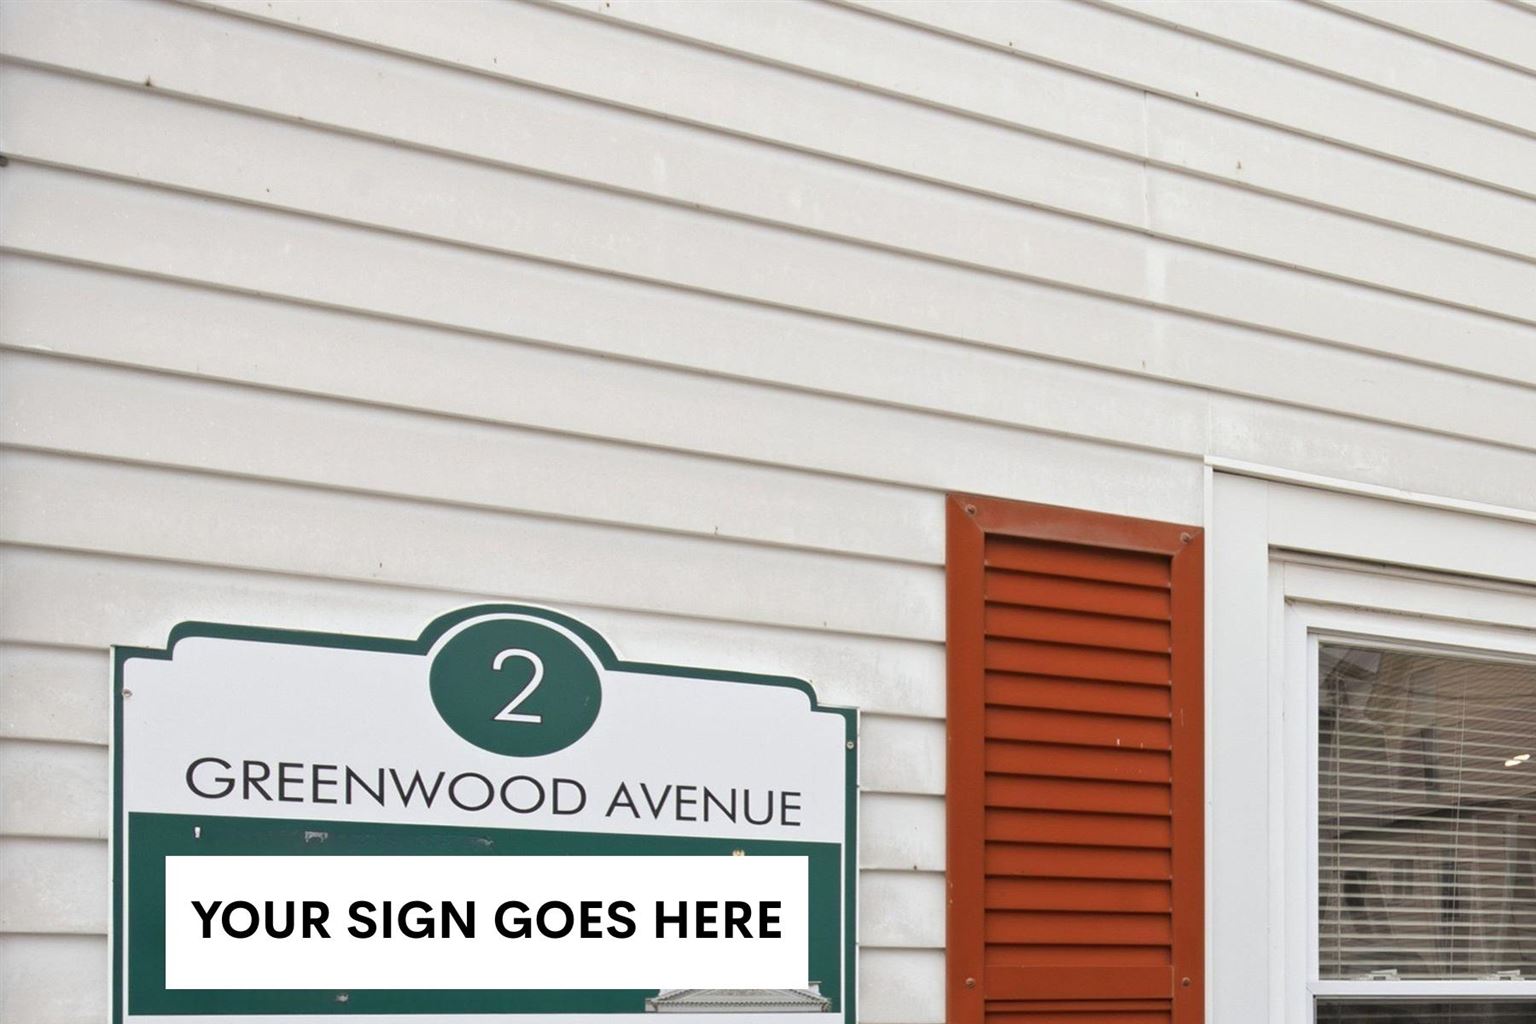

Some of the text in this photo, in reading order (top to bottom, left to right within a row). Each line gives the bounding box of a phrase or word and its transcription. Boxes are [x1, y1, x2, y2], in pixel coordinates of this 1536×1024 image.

[491, 648, 543, 723] 2
[185, 756, 801, 827] GREENWOOD AVENUE
